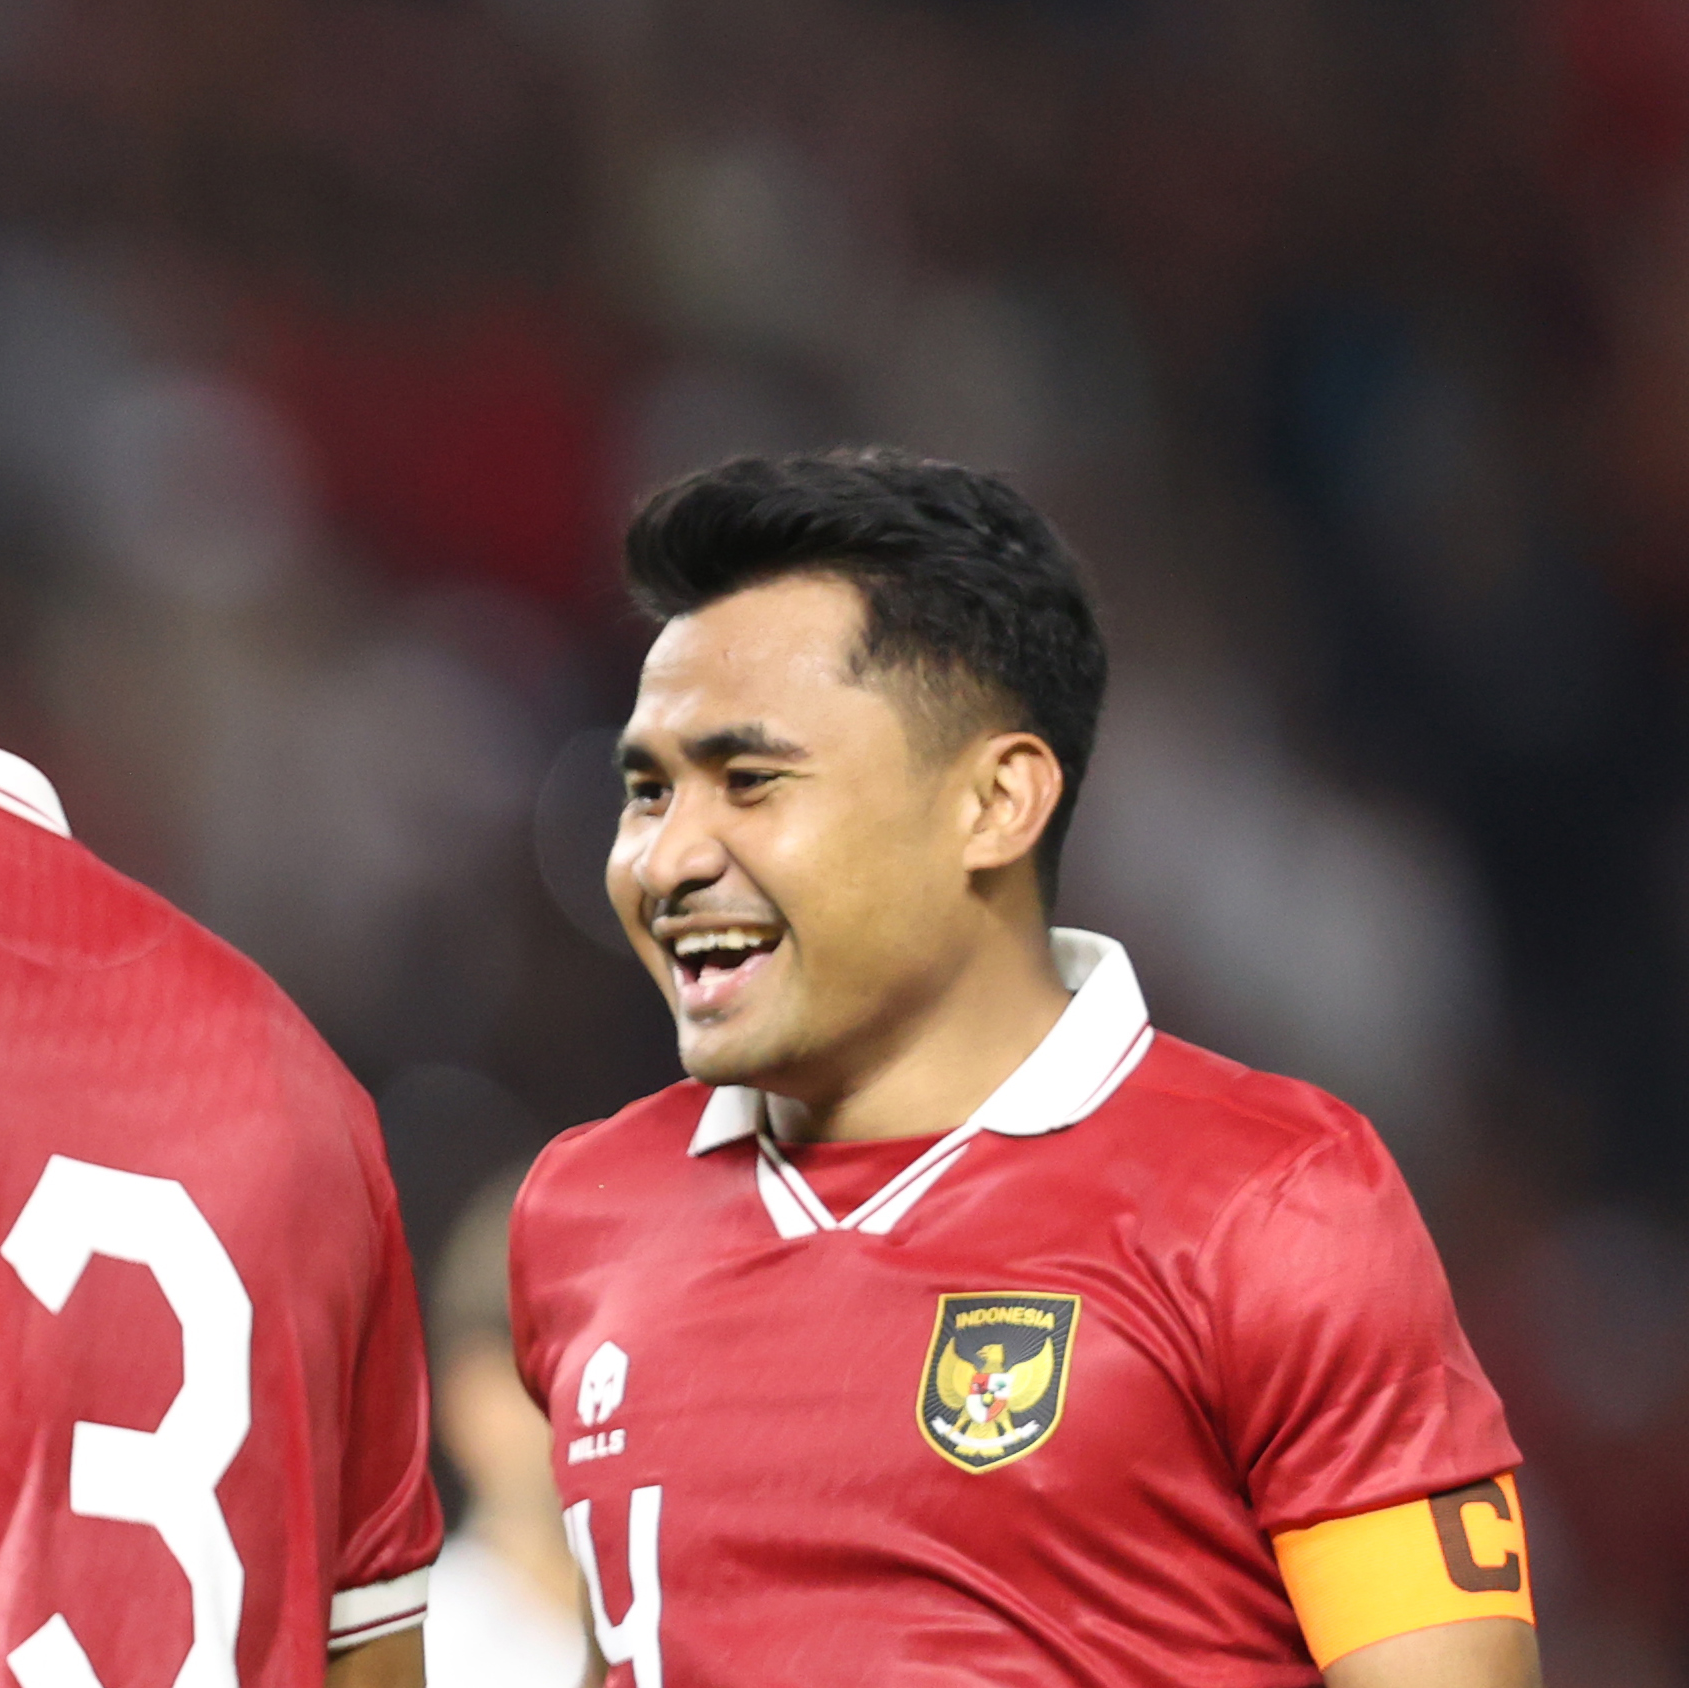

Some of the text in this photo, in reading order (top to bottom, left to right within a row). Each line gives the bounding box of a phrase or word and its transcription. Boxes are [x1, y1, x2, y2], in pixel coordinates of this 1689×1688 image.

[955, 1307, 1055, 1330] INDONESIA
[569, 1428, 626, 1465] MILLS
[1429, 1477, 1521, 1592] C
